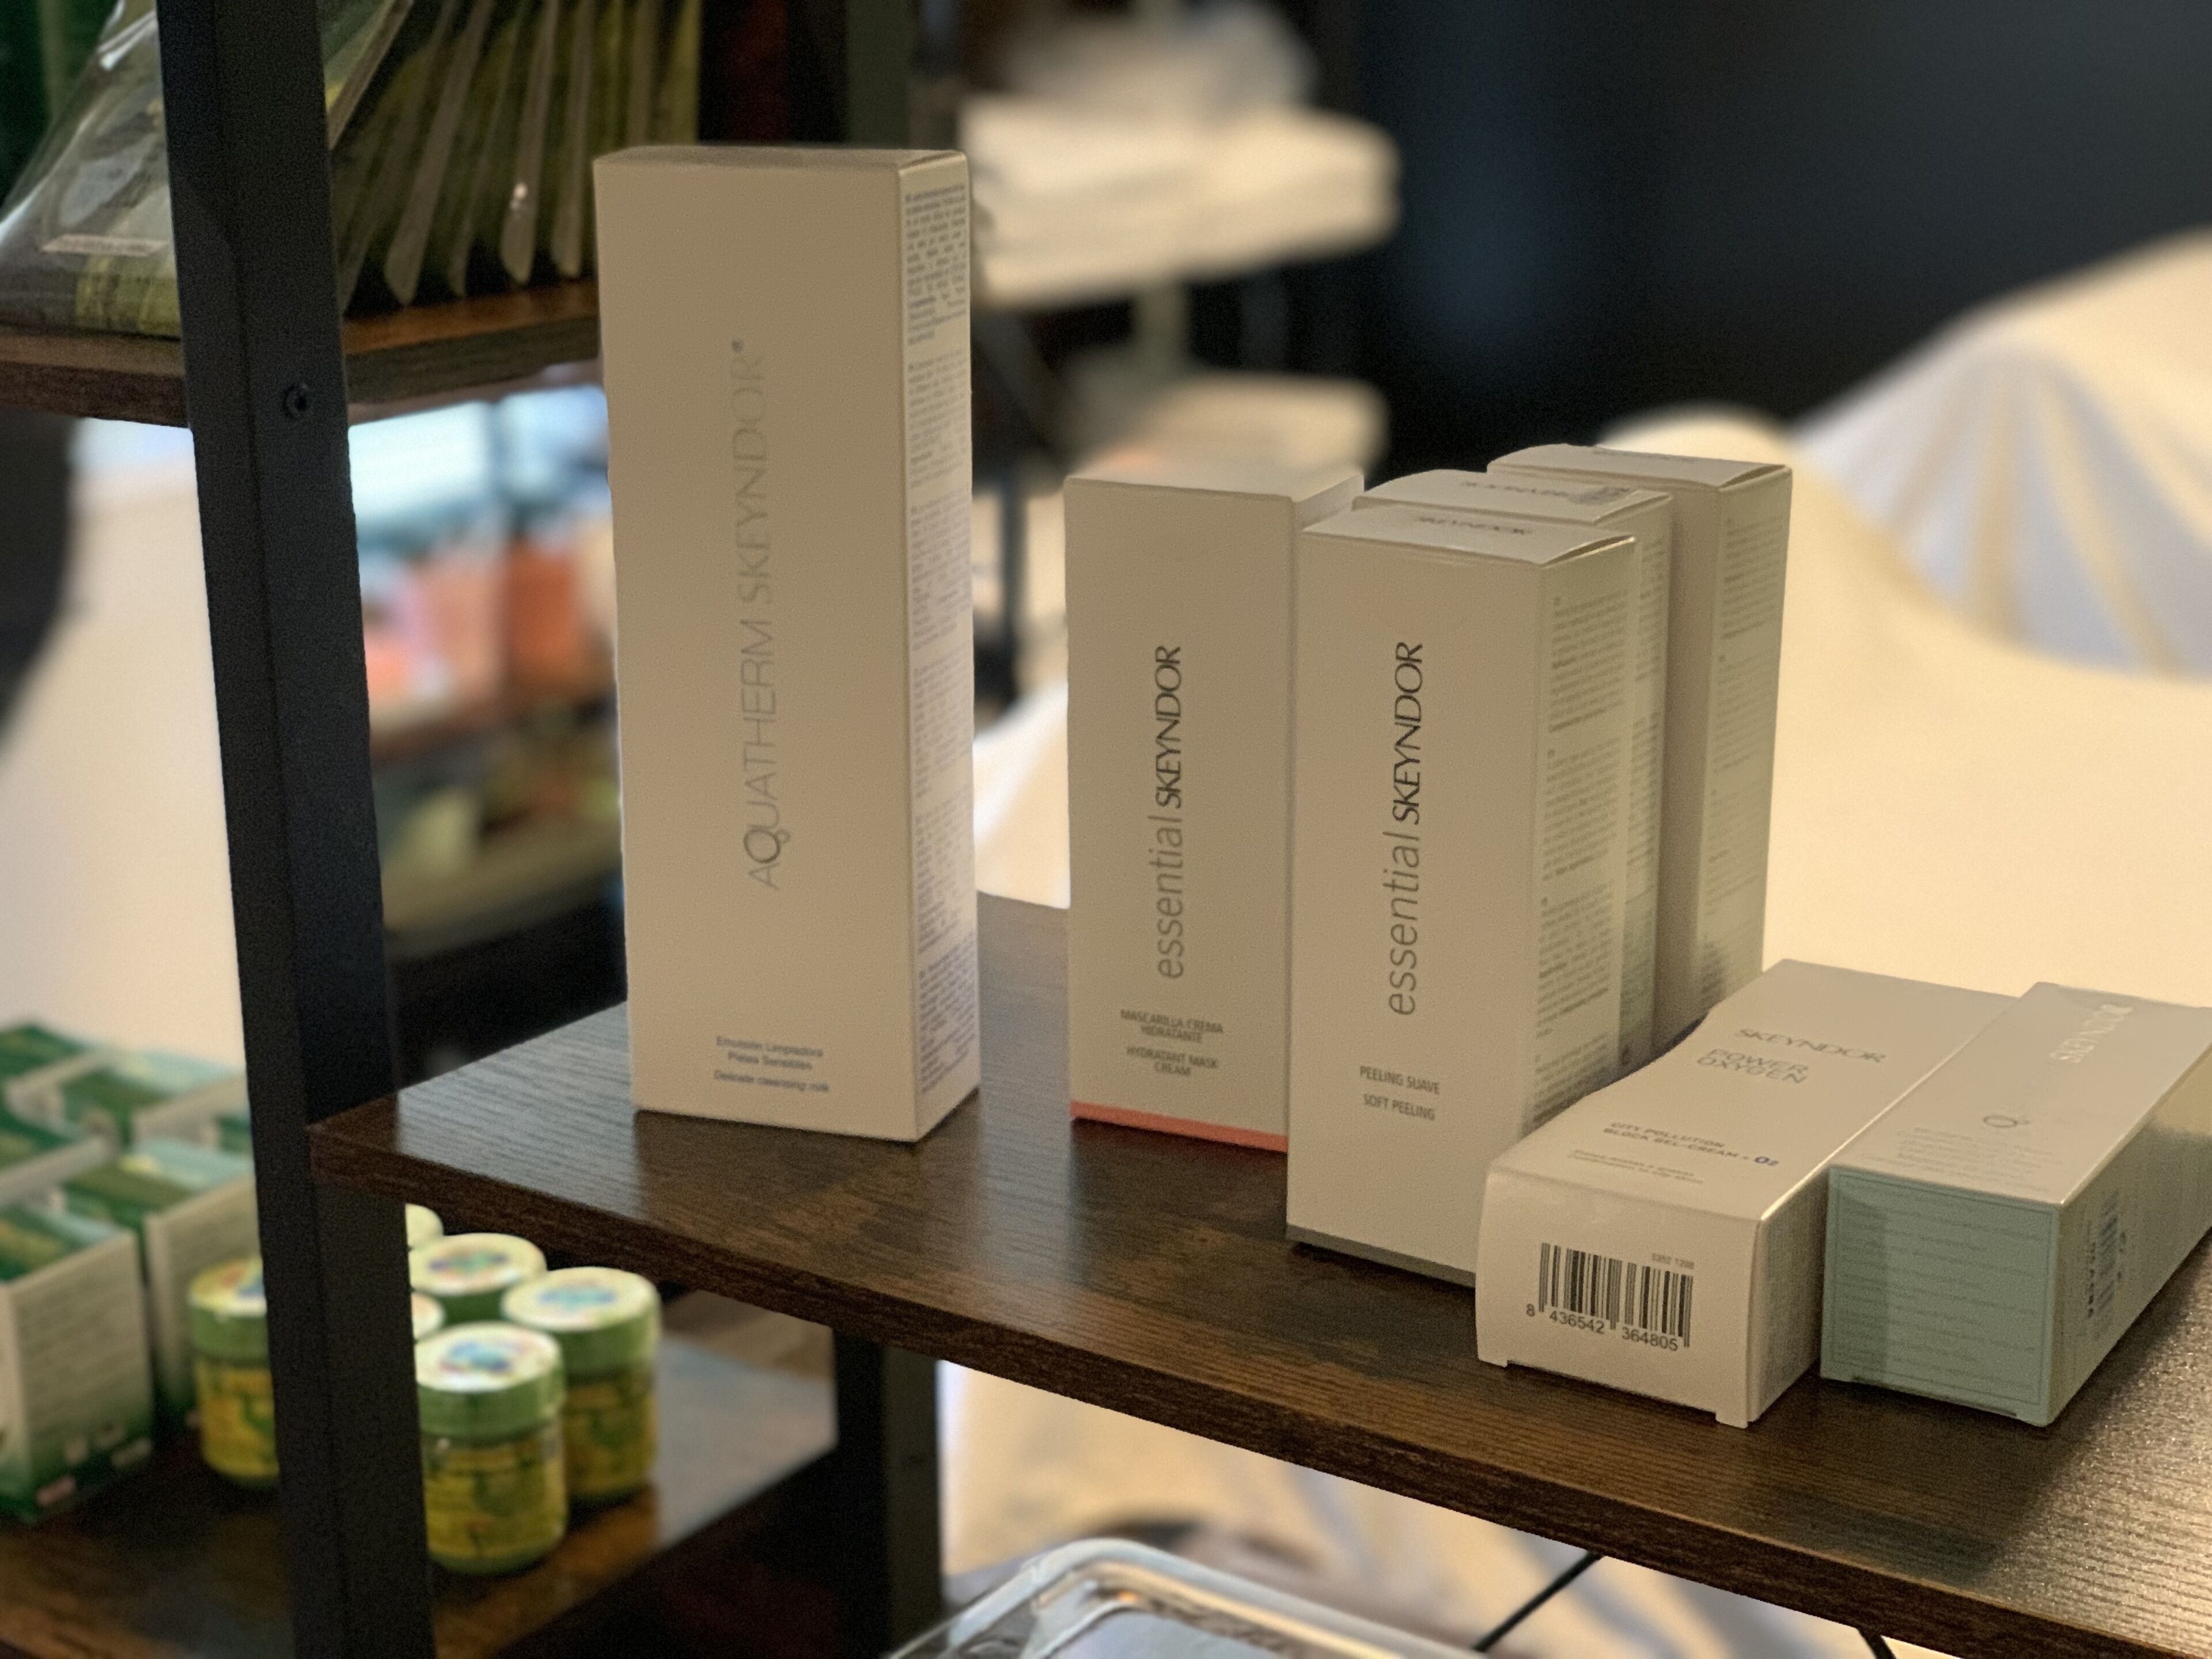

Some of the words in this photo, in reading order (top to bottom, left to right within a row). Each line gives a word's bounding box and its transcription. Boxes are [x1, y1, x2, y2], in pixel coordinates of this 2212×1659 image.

[1154, 645, 1183, 809] SKEYNDOR
[1392, 641, 1423, 825] SKEYNDOR
[741, 620, 790, 890] AQUATHERM
[1149, 815, 1184, 979] essential
[1383, 831, 1419, 1016] essential
[1187, 1019, 1224, 1033] CREMA
[1708, 1048, 1809, 1073] POWER
[1737, 1029, 1886, 1063] SKEYNDOR
[1359, 1066, 1403, 1086] PEELING
[1407, 1075, 1440, 1095] SUAVE
[1697, 1056, 1808, 1084] OXYGEN
[1363, 1094, 1389, 1109] SOFT
[1392, 1099, 1435, 1121] PEELING
[1603, 1127, 1649, 1142] BLOCK
[1611, 1122, 1640, 1132] CITY
[1644, 1128, 1725, 1148] POLLUTION
[1527, 1303, 1535, 1317] 8
[1550, 1310, 1605, 1335] 436542
[1622, 1326, 1679, 1352] 364805
